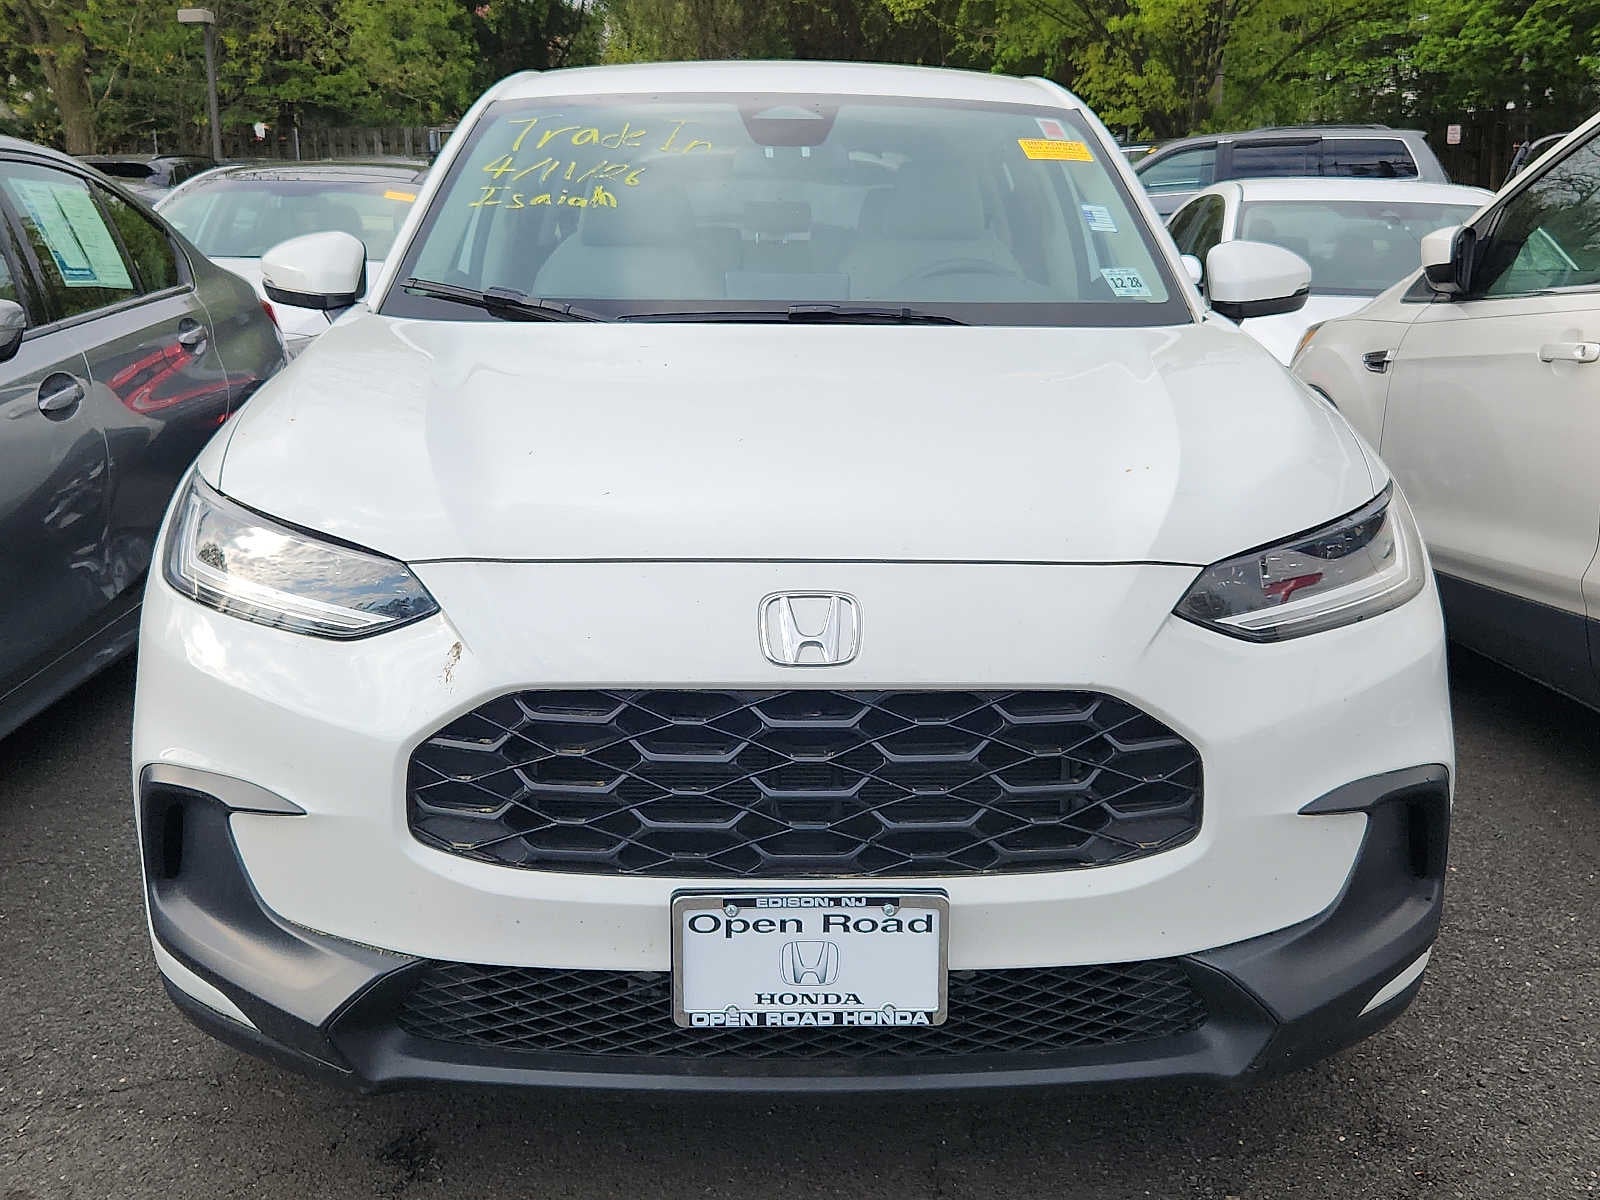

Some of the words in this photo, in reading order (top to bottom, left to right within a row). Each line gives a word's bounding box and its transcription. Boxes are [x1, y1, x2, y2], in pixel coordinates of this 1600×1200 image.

[508, 114, 646, 152] Trade
[659, 119, 713, 154] In
[841, 897, 867, 907] NJ
[688, 914, 803, 938] Open
[822, 913, 933, 934] Road
[754, 992, 864, 1006] HONDA
[692, 1012, 757, 1026] OPEN
[765, 1011, 834, 1026] ROAD
[841, 1010, 930, 1025] HONDA
